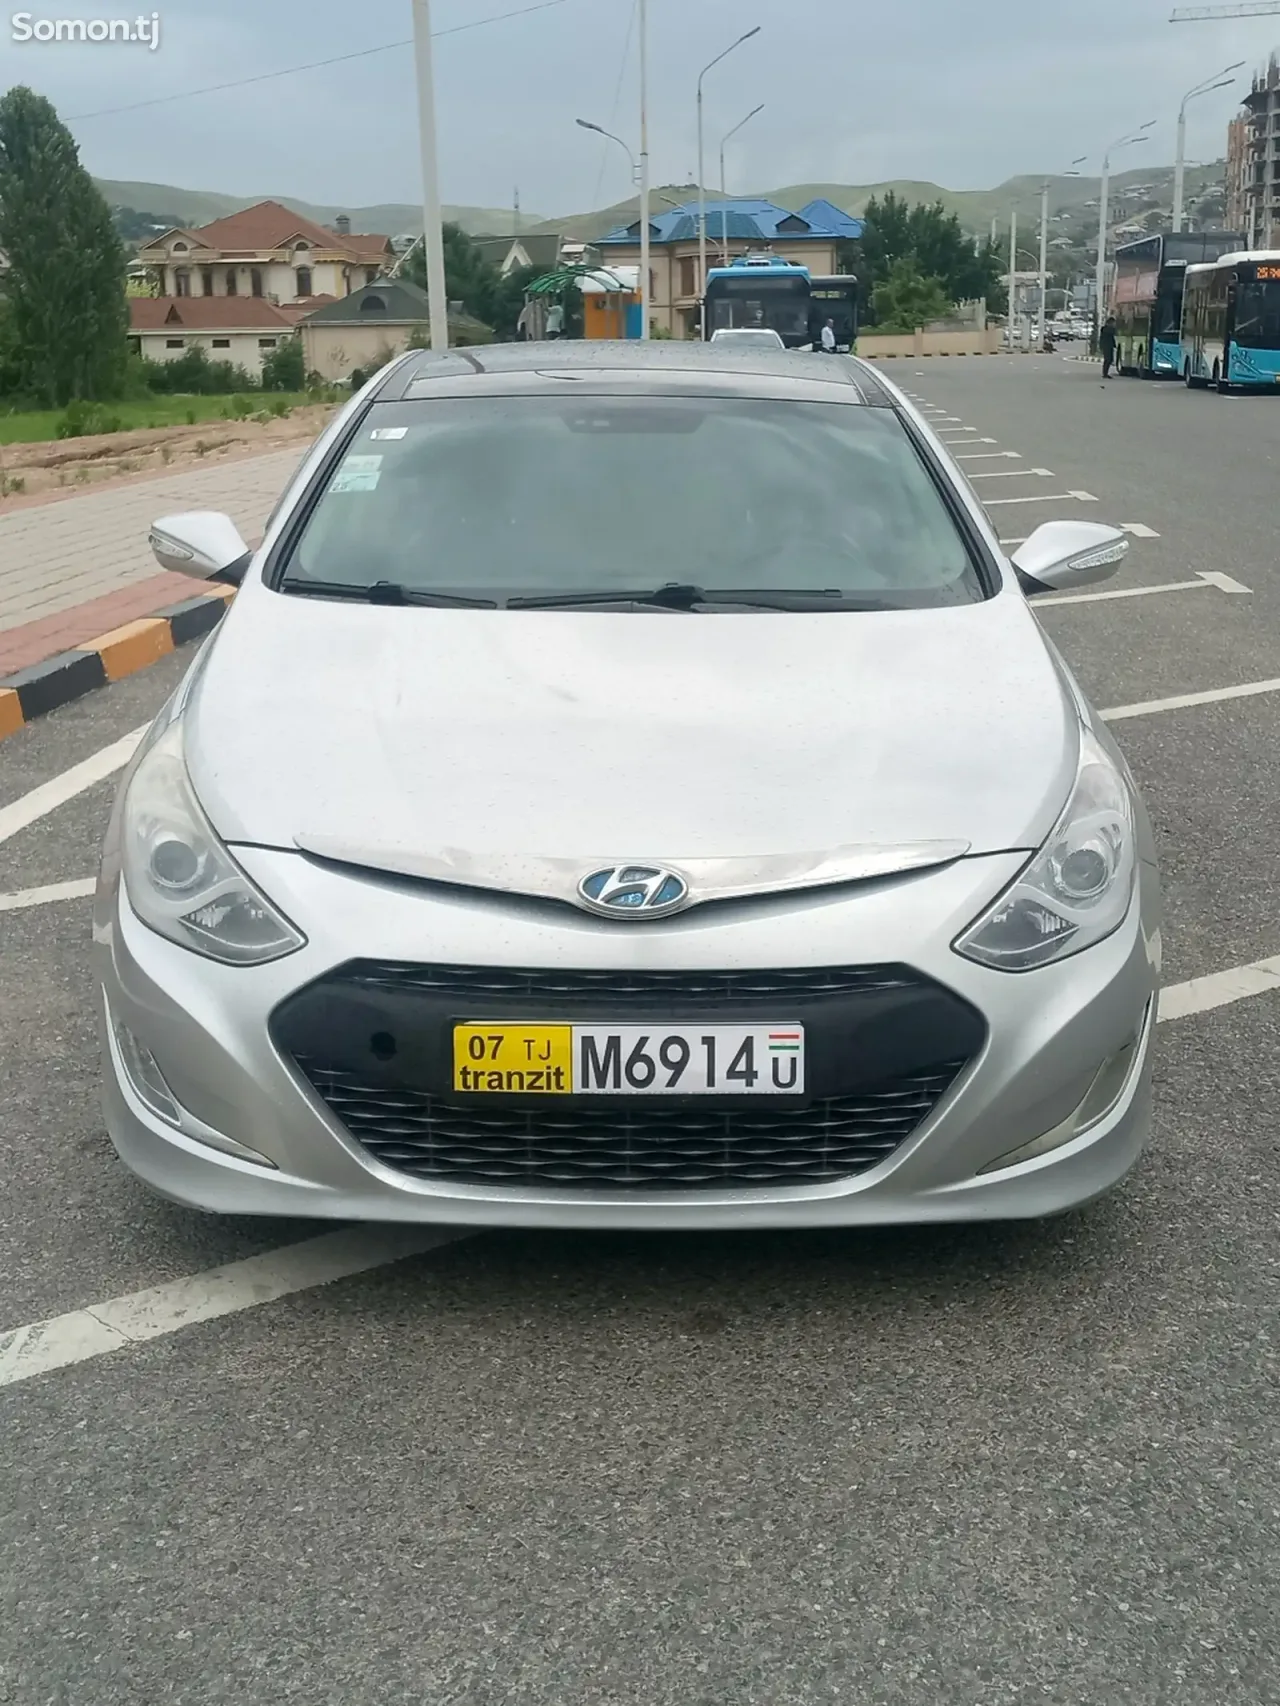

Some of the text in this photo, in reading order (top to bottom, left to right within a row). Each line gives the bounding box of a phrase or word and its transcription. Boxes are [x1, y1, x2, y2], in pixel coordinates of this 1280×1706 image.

[468, 1035, 551, 1061] 07 TJ
[580, 1035, 797, 1089] M6914 U
[460, 1066, 565, 1091] tranzit
